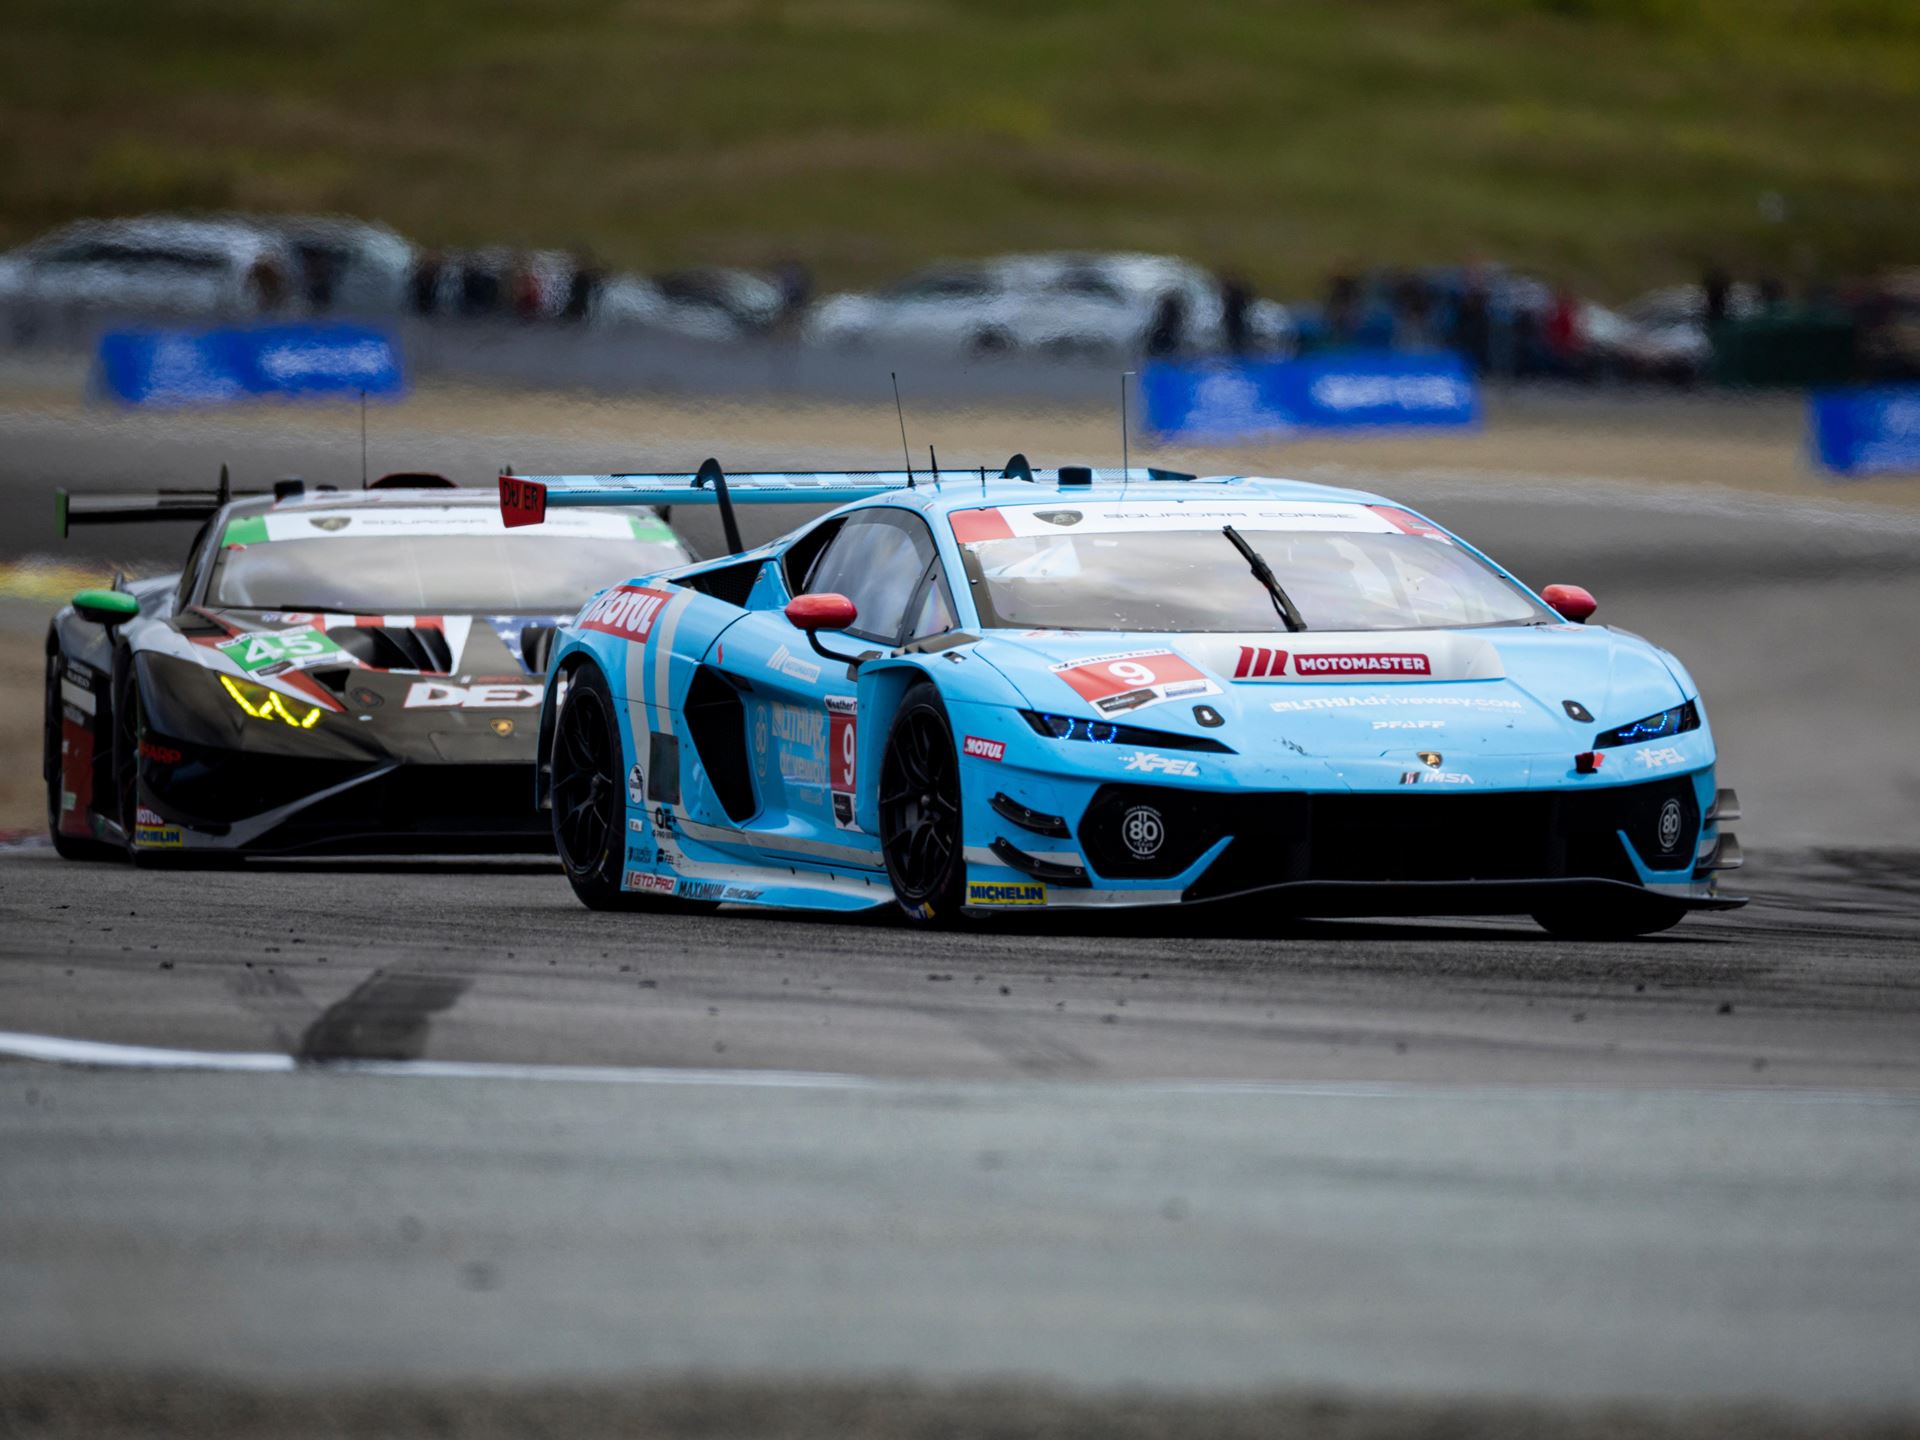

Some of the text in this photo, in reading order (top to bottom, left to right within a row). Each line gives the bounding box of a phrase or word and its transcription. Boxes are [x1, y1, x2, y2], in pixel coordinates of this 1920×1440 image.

[1104, 511, 1356, 520] SQUADRA CORSE
[583, 590, 664, 635] MOTUL
[244, 633, 324, 663] 45
[1054, 648, 1168, 669] WeatherTech
[1107, 660, 1156, 686] 9
[1299, 656, 1426, 671] MOTOMASTER
[1371, 720, 1446, 730] PFAFF
[843, 723, 855, 786] 9
[965, 738, 1003, 759] MOTUL
[1634, 747, 1687, 769] XPEL
[1124, 751, 1200, 777] XPEL
[1423, 771, 1475, 785] IMSA
[1129, 820, 1158, 841] 80
[1662, 814, 1677, 834] 80
[655, 877, 676, 891] PRO
[970, 885, 1044, 900] MICHELIN
